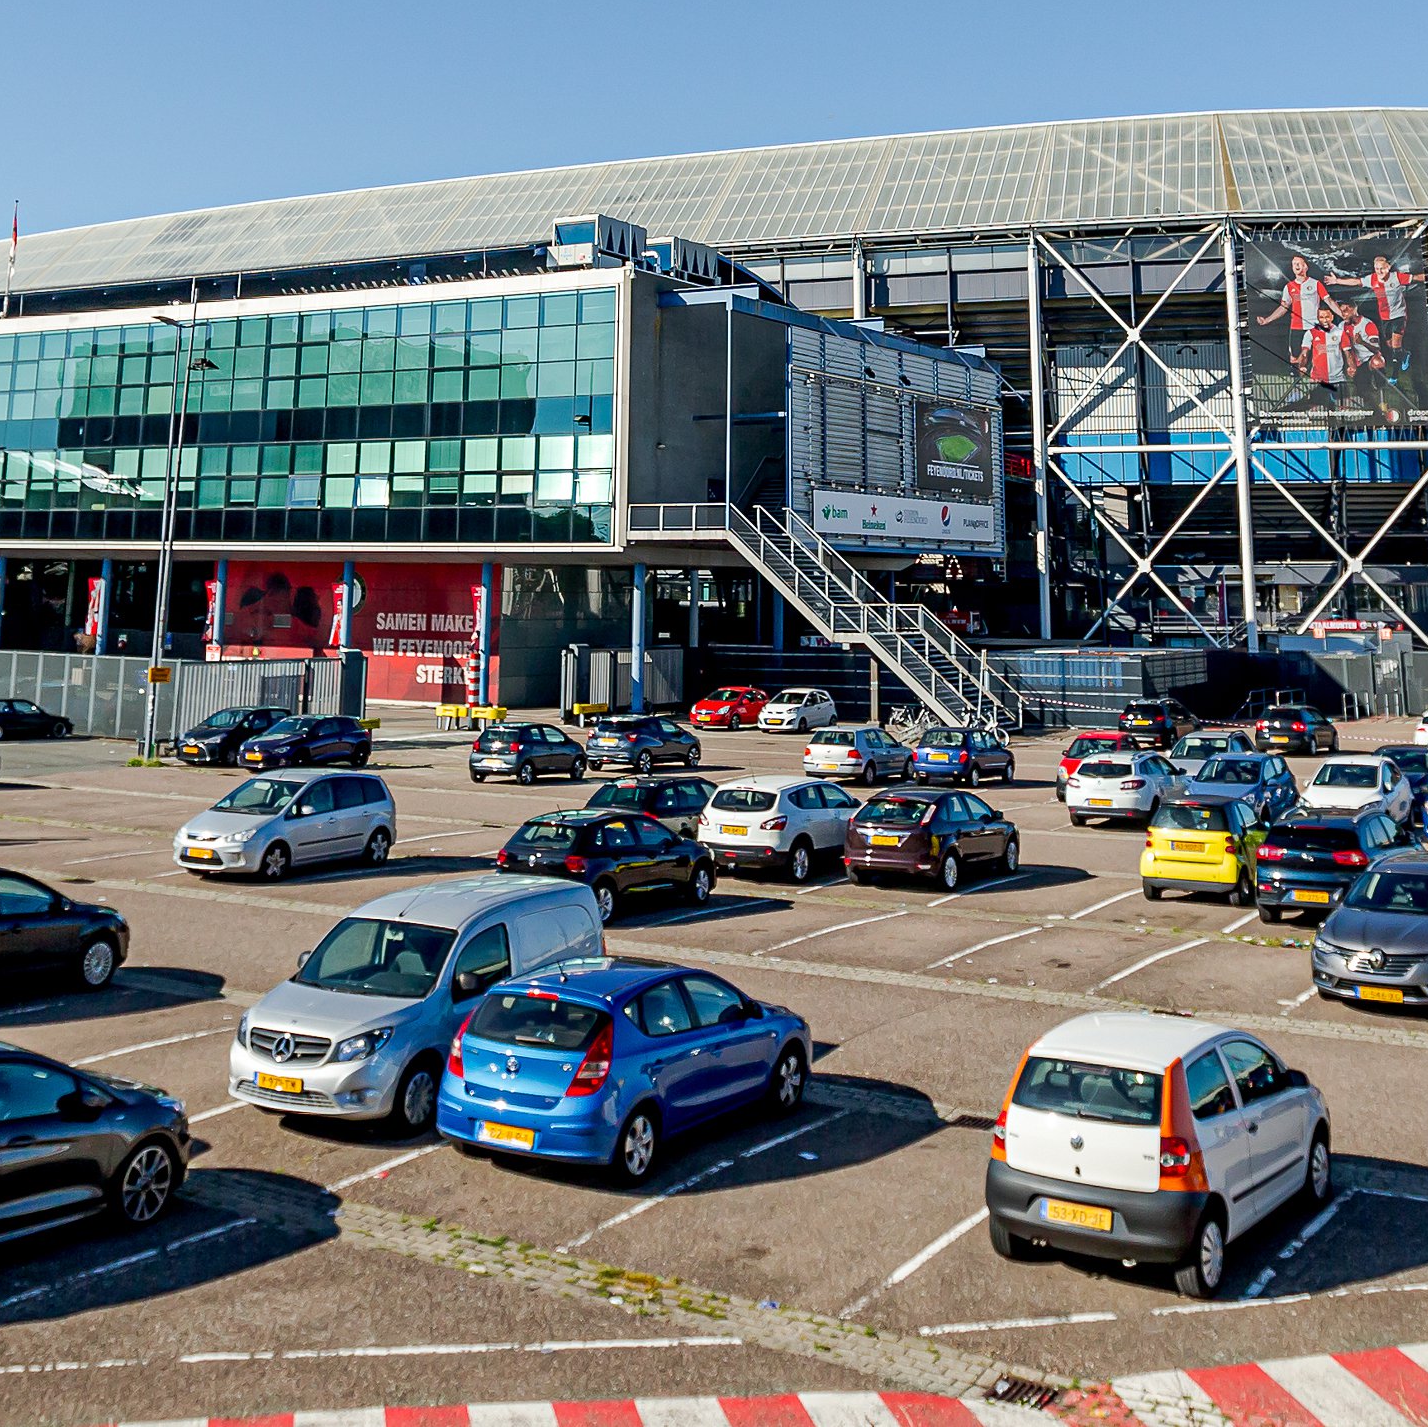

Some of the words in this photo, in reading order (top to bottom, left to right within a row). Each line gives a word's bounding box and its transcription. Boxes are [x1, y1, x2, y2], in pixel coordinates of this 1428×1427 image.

[832, 504, 848, 519] bam
[376, 613, 426, 631] SAMEN
[431, 614, 473, 633] MAKE
[373, 638, 395, 655] WE
[398, 639, 471, 659] FEYENOOR
